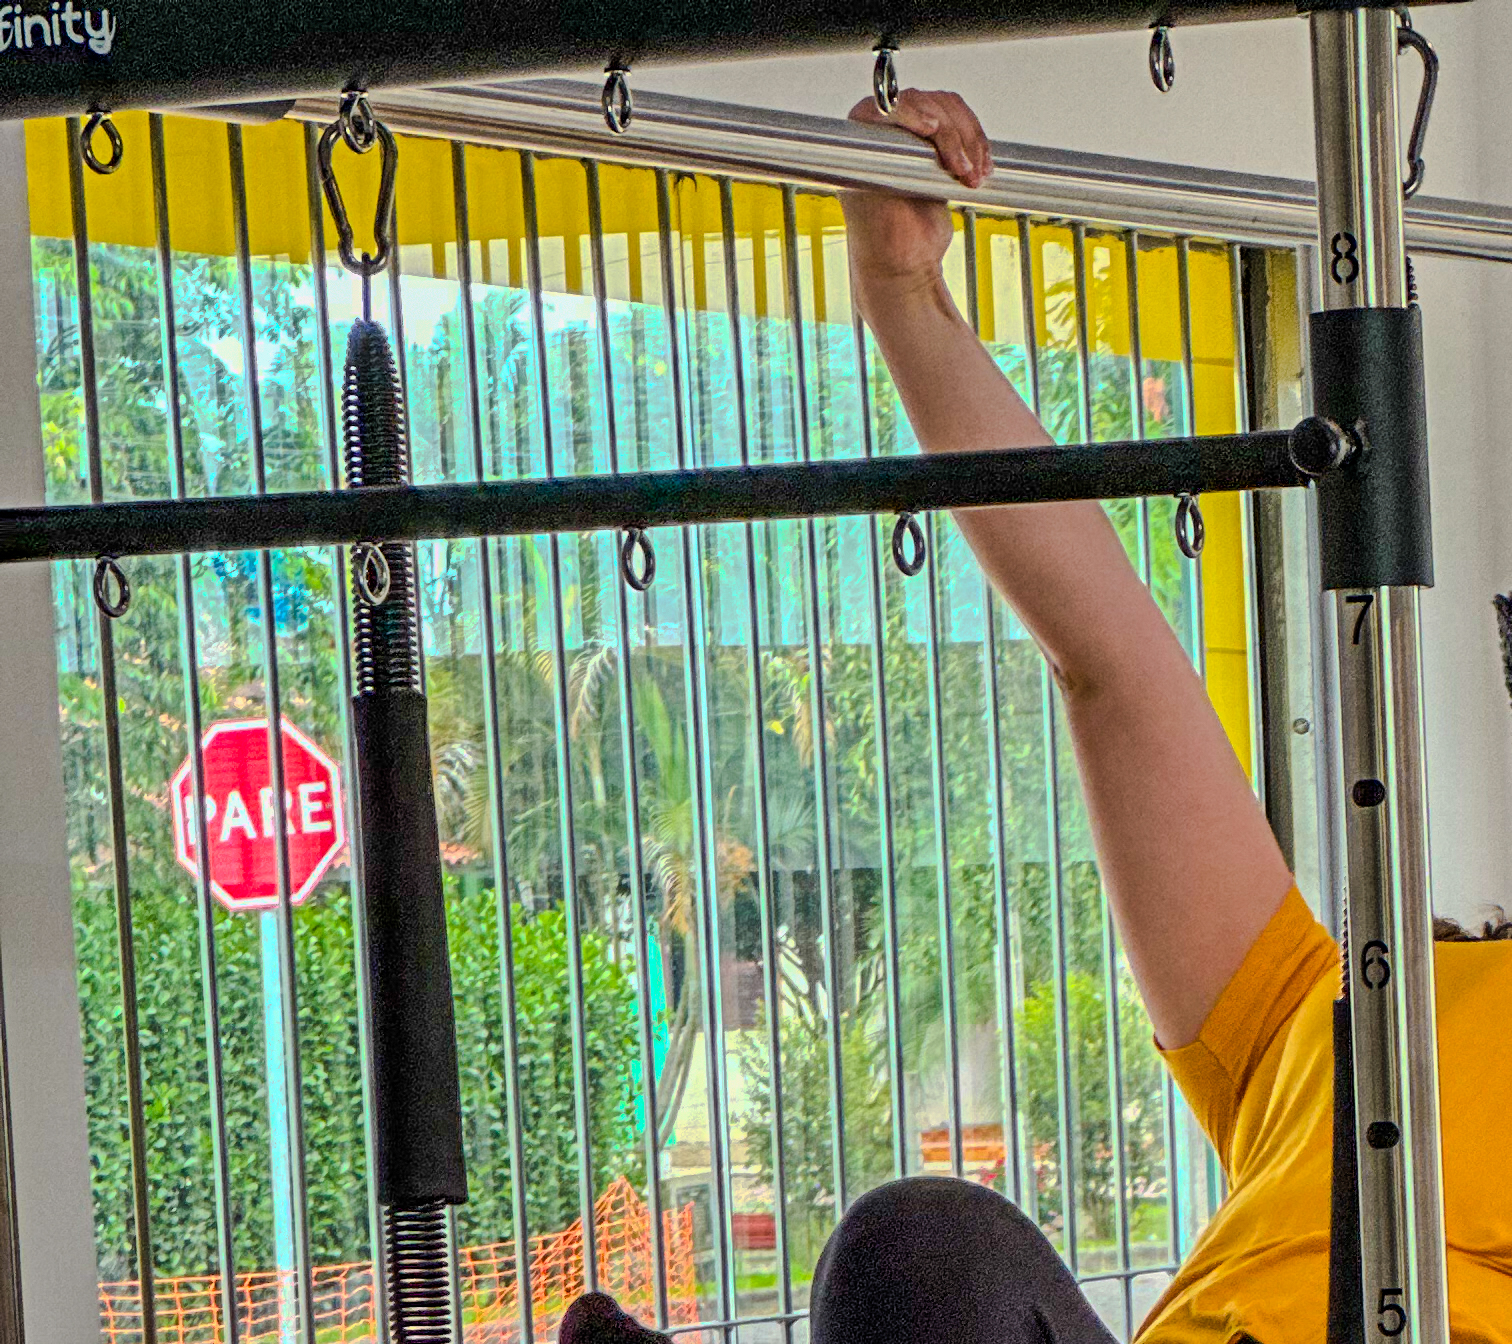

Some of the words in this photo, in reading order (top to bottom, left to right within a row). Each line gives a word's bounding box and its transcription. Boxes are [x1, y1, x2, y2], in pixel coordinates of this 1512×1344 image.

[0, 1, 116, 54] finity
[1330, 231, 1359, 285] 8
[1345, 595, 1374, 645] 7
[184, 781, 332, 846] PARE
[1360, 940, 1391, 991] 6
[1377, 1288, 1407, 1337] 5
